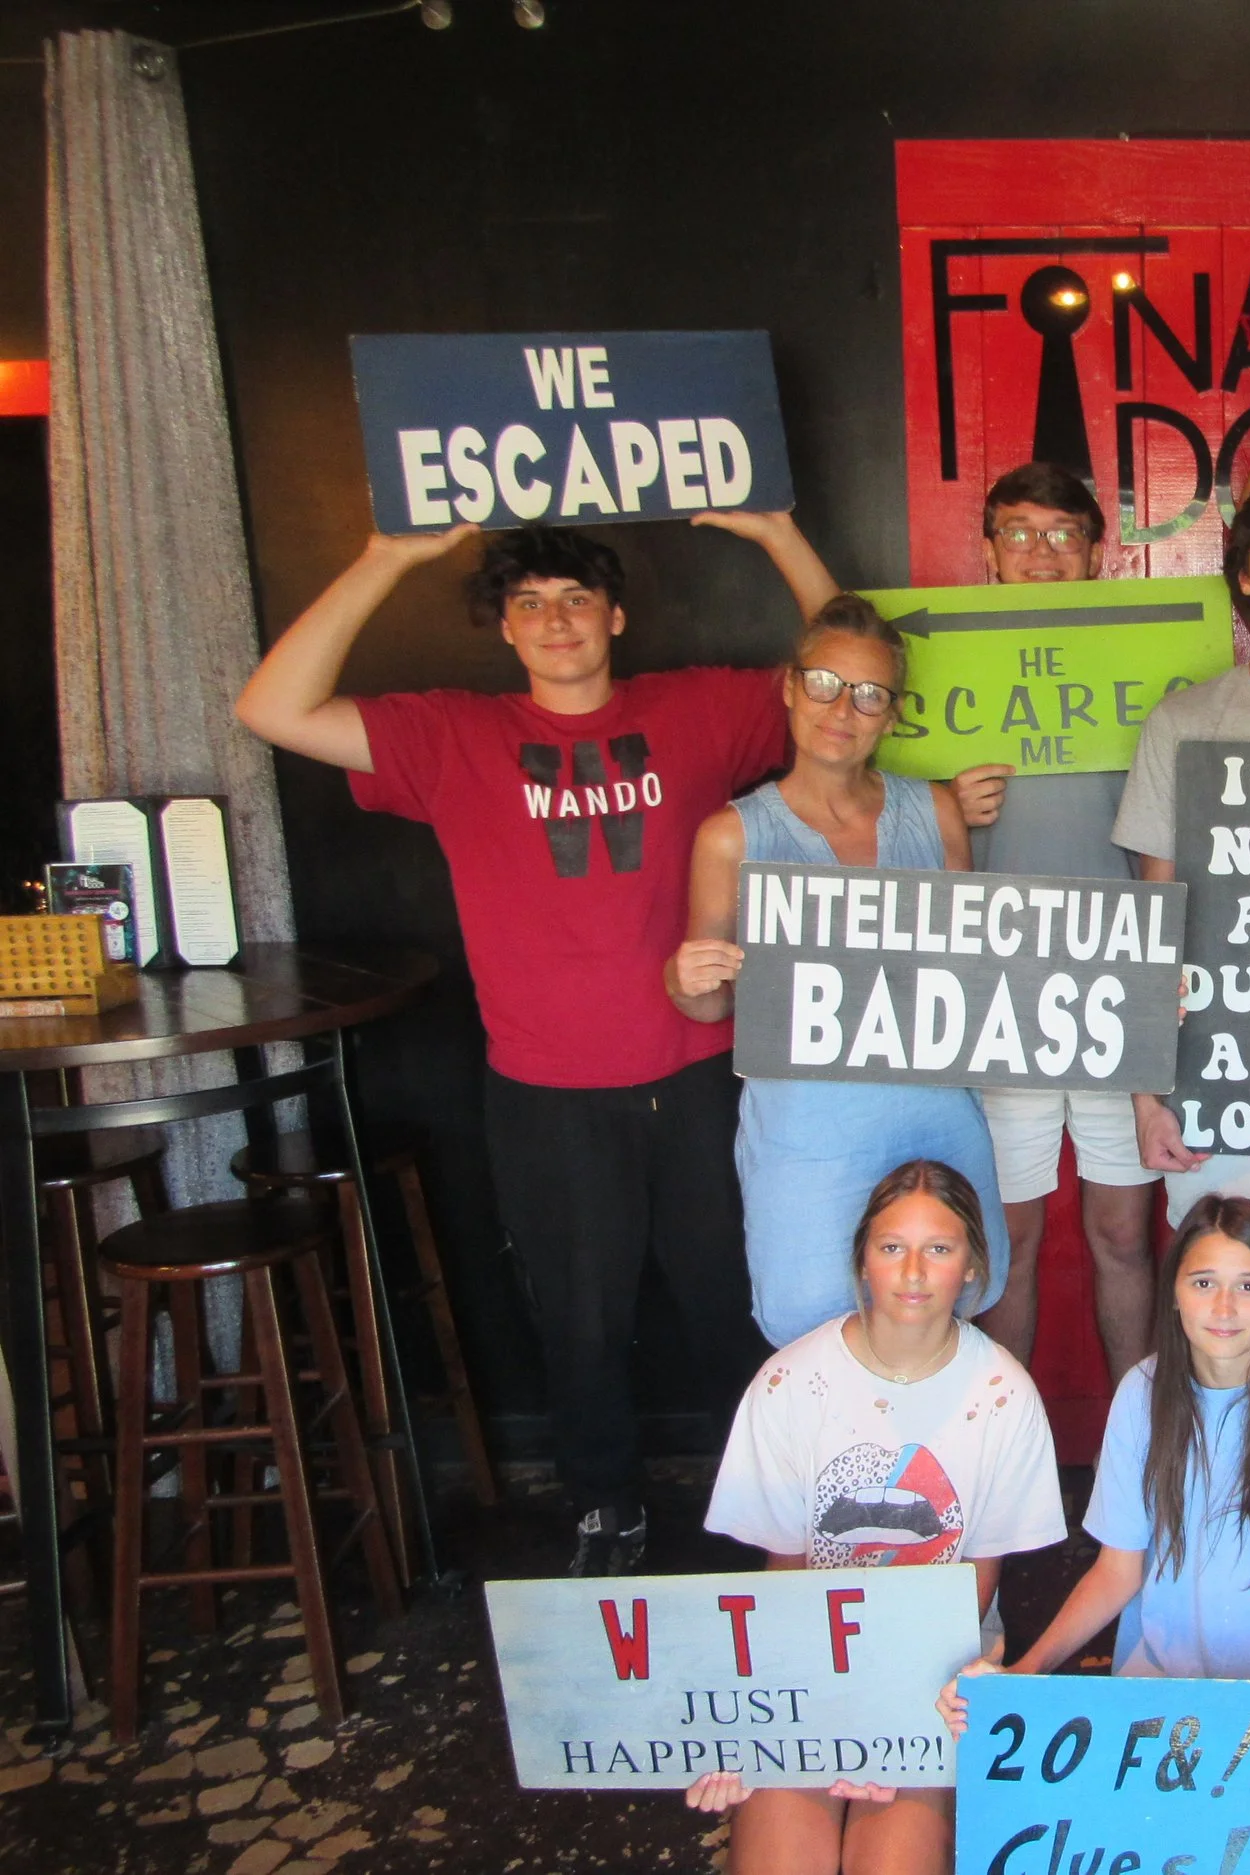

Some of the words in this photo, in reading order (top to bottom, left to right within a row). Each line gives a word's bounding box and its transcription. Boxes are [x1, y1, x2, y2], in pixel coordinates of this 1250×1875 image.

[523, 347, 615, 410] WE
[398, 418, 752, 526] ESCAPED
[1019, 647, 1066, 677] HE
[892, 676, 1196, 738] SCARE
[1021, 735, 1076, 767] ME
[523, 772, 662, 819] WANDO
[747, 874, 1176, 964] INTELLECTUAL
[790, 961, 1125, 1078] BADASS
[680, 1688, 809, 1725] JUST
[561, 1735, 946, 1775] HAPPENED?!?!
[986, 1713, 1093, 1784] 20
